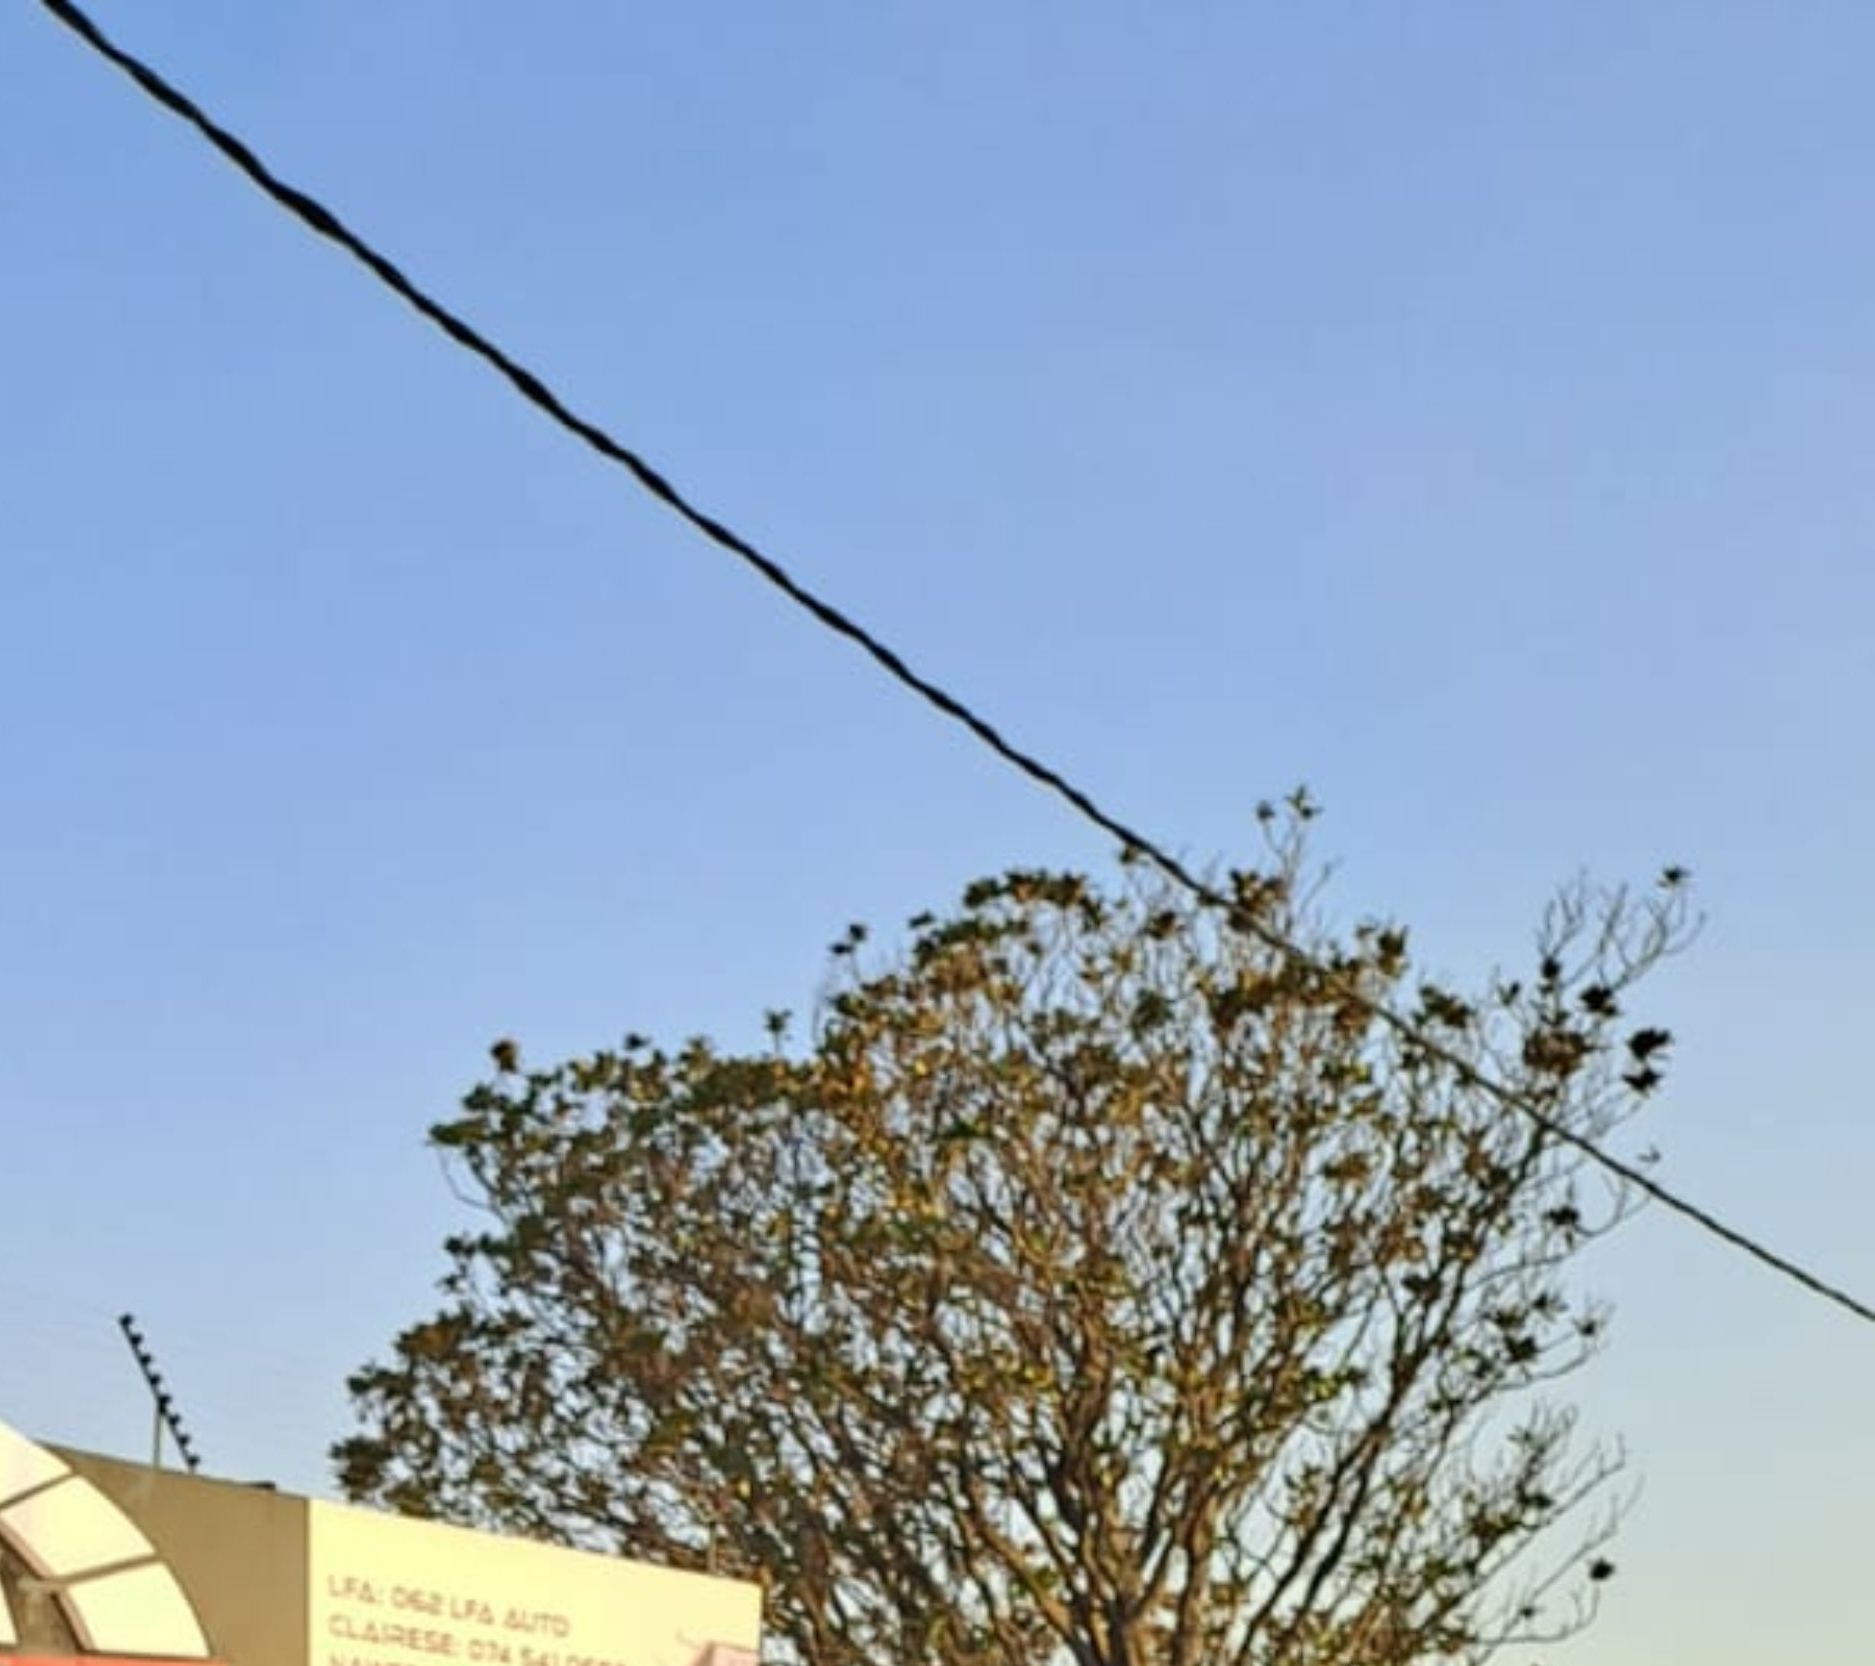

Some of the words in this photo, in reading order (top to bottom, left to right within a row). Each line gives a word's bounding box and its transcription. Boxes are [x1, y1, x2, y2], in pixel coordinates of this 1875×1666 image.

[449, 1594, 495, 1625] LFA
[503, 1607, 570, 1638] AUTO
[467, 1637, 511, 1664] 074
